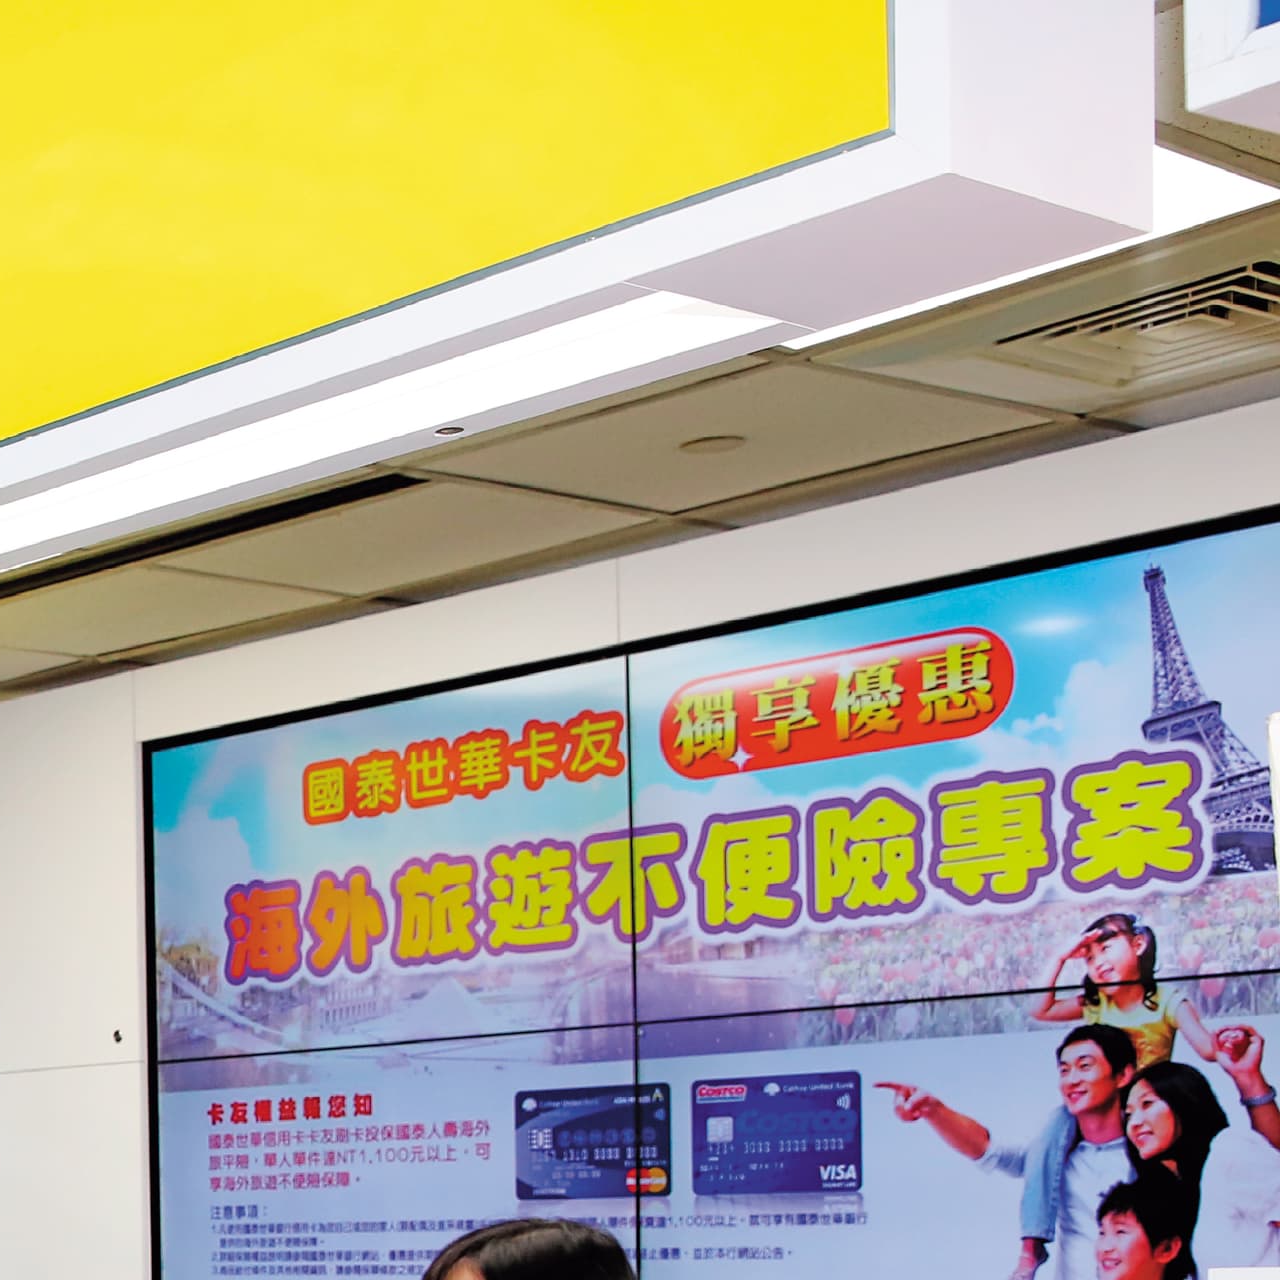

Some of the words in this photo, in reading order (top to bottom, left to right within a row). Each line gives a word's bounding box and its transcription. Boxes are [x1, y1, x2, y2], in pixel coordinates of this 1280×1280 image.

[672, 640, 995, 770] 獨享優惠
[308, 718, 620, 816] 國泰世華卡友
[228, 760, 1192, 981] 海外旅遊不便險專案
[819, 1164, 857, 1181] VISA
